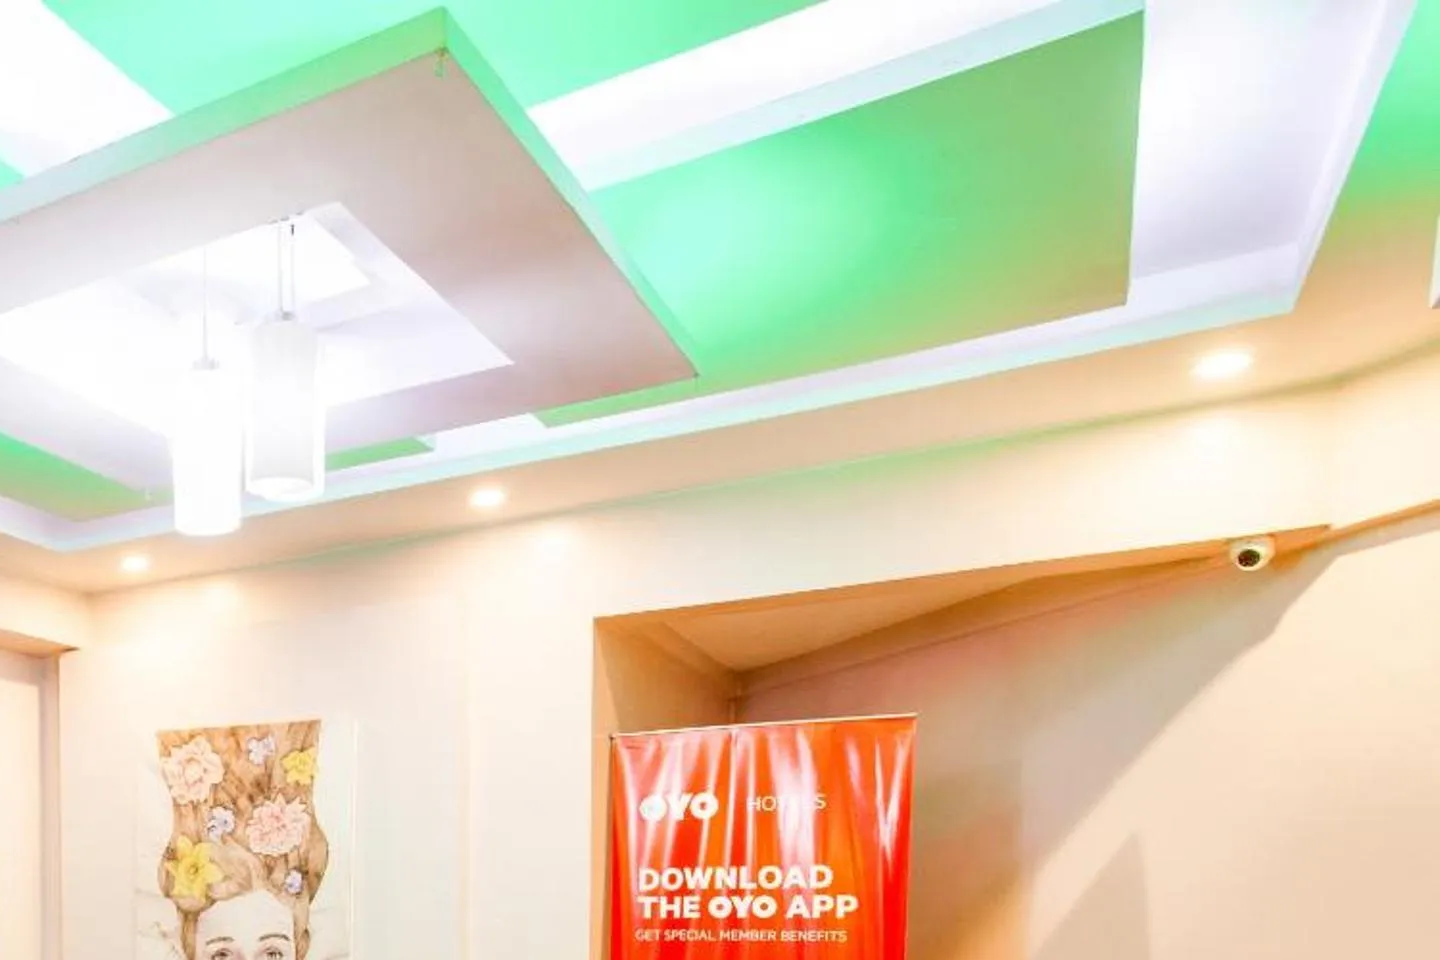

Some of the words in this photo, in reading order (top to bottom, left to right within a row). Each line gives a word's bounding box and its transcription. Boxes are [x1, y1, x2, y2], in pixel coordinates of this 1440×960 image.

[640, 792, 719, 821] OYO
[638, 865, 834, 891] DOWNLOAD
[637, 896, 701, 919] THE
[708, 895, 777, 919] OYO
[785, 895, 859, 919] APP
[635, 929, 661, 942] GET
[663, 929, 717, 942] SPECIAL
[719, 929, 777, 942] MEMBER
[780, 929, 848, 942] BENEFITS
